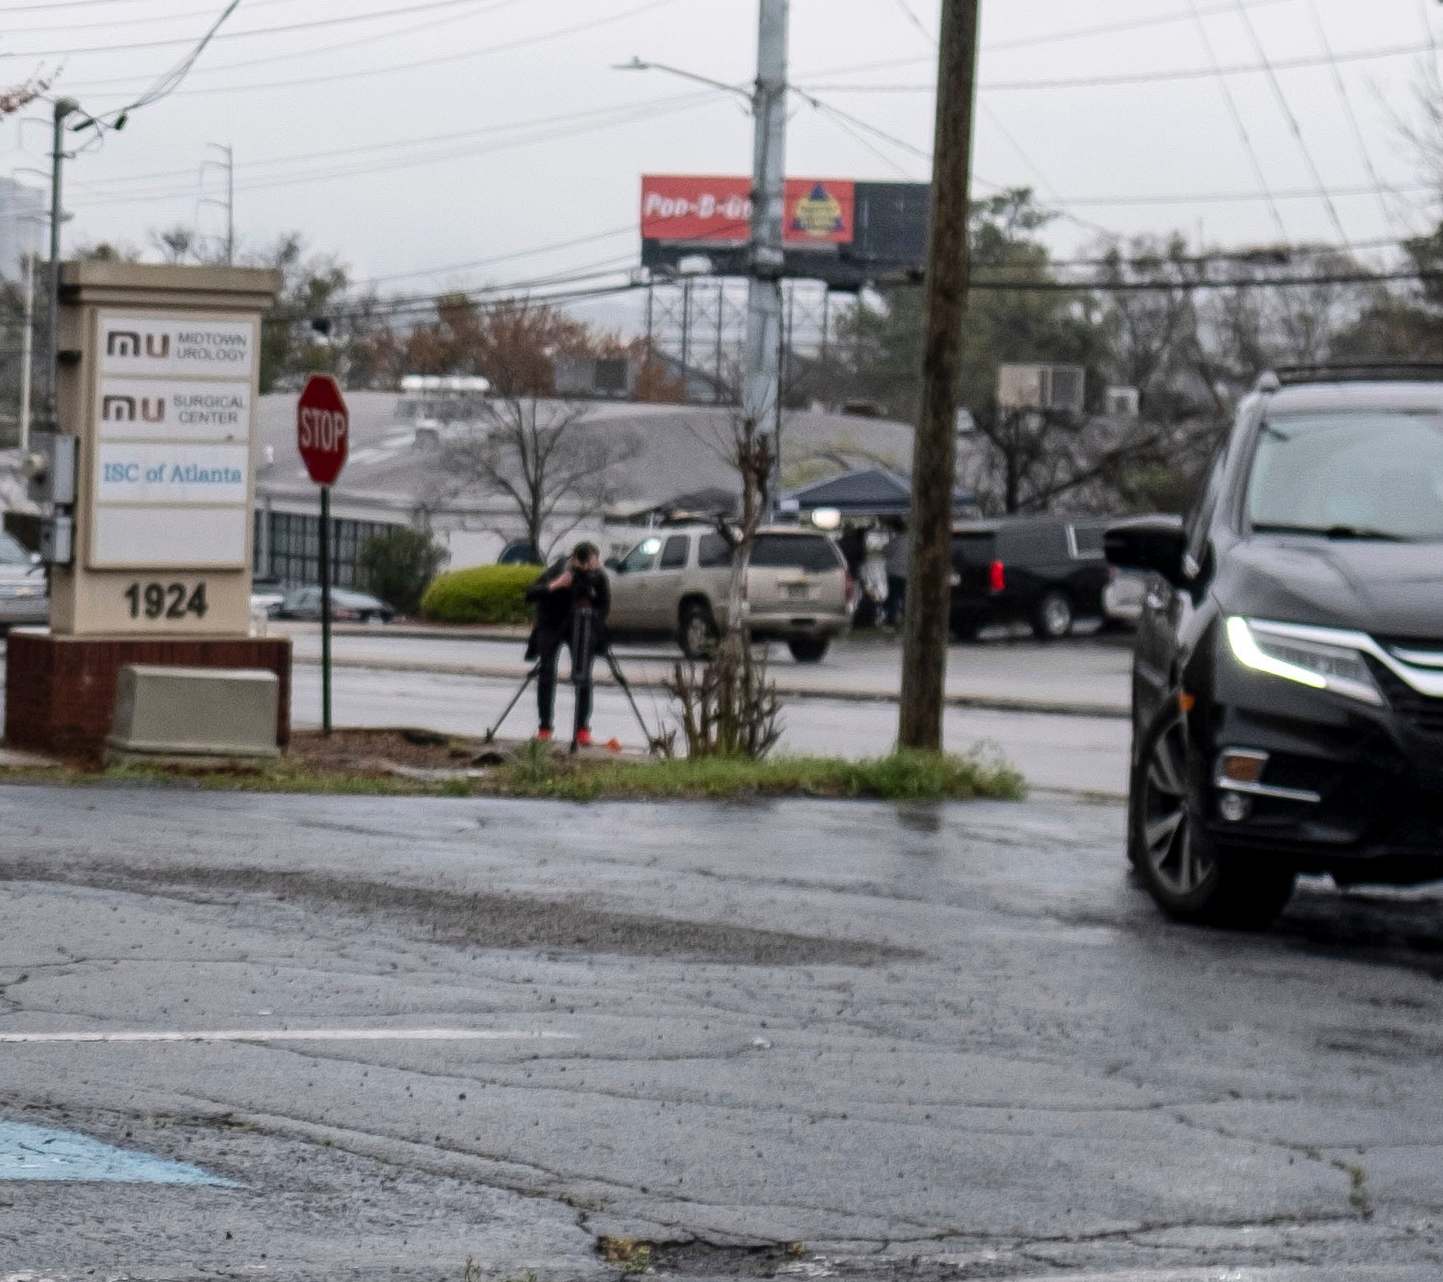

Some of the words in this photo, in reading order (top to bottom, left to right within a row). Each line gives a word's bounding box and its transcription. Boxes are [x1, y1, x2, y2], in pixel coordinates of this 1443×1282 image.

[176, 347, 247, 361] UROLOGY
[177, 411, 239, 425] CENTER
[301, 407, 346, 453] STOP
[104, 463, 139, 482] ISC
[145, 463, 166, 482] of
[170, 463, 242, 484] Atlanta
[124, 581, 209, 619] 1924
